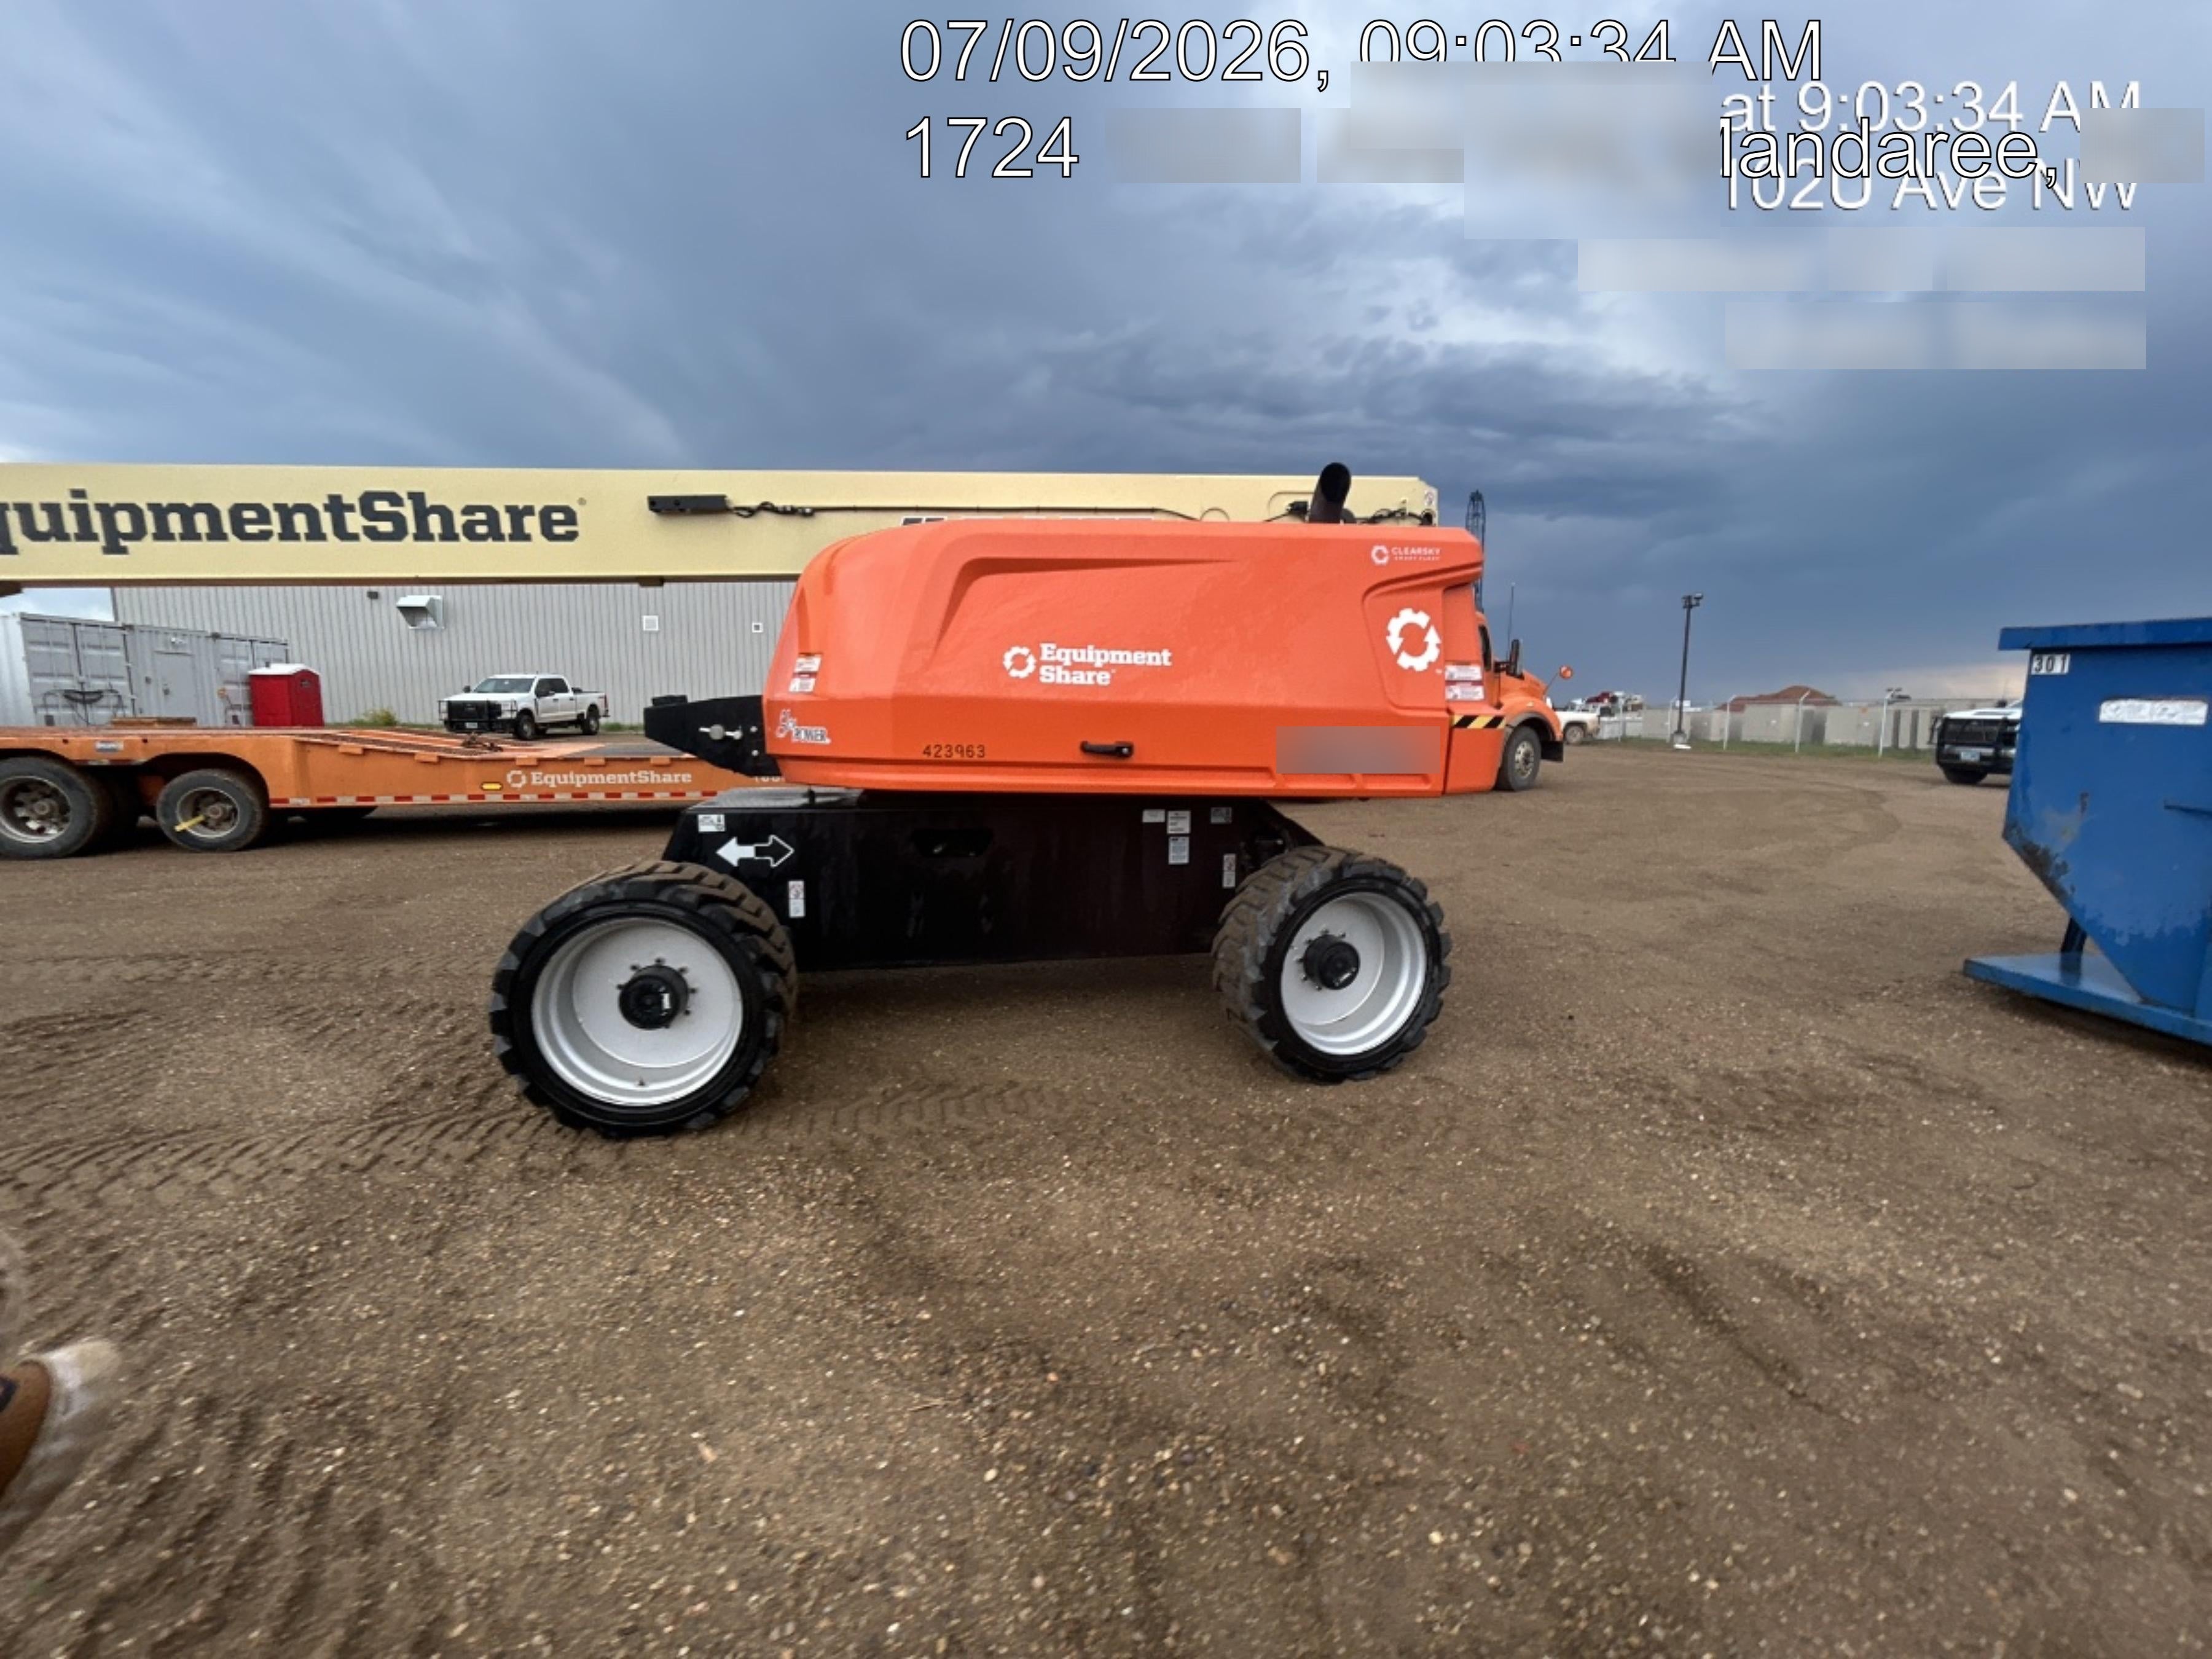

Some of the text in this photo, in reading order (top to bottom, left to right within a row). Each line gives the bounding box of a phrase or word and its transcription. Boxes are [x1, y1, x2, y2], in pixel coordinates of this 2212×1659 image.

[1039, 643, 1172, 668] Equipment
[2034, 654, 2067, 673] 301
[1039, 665, 1111, 686] Share
[922, 744, 985, 758] 423963
[530, 769, 692, 788] EquipmentShare
